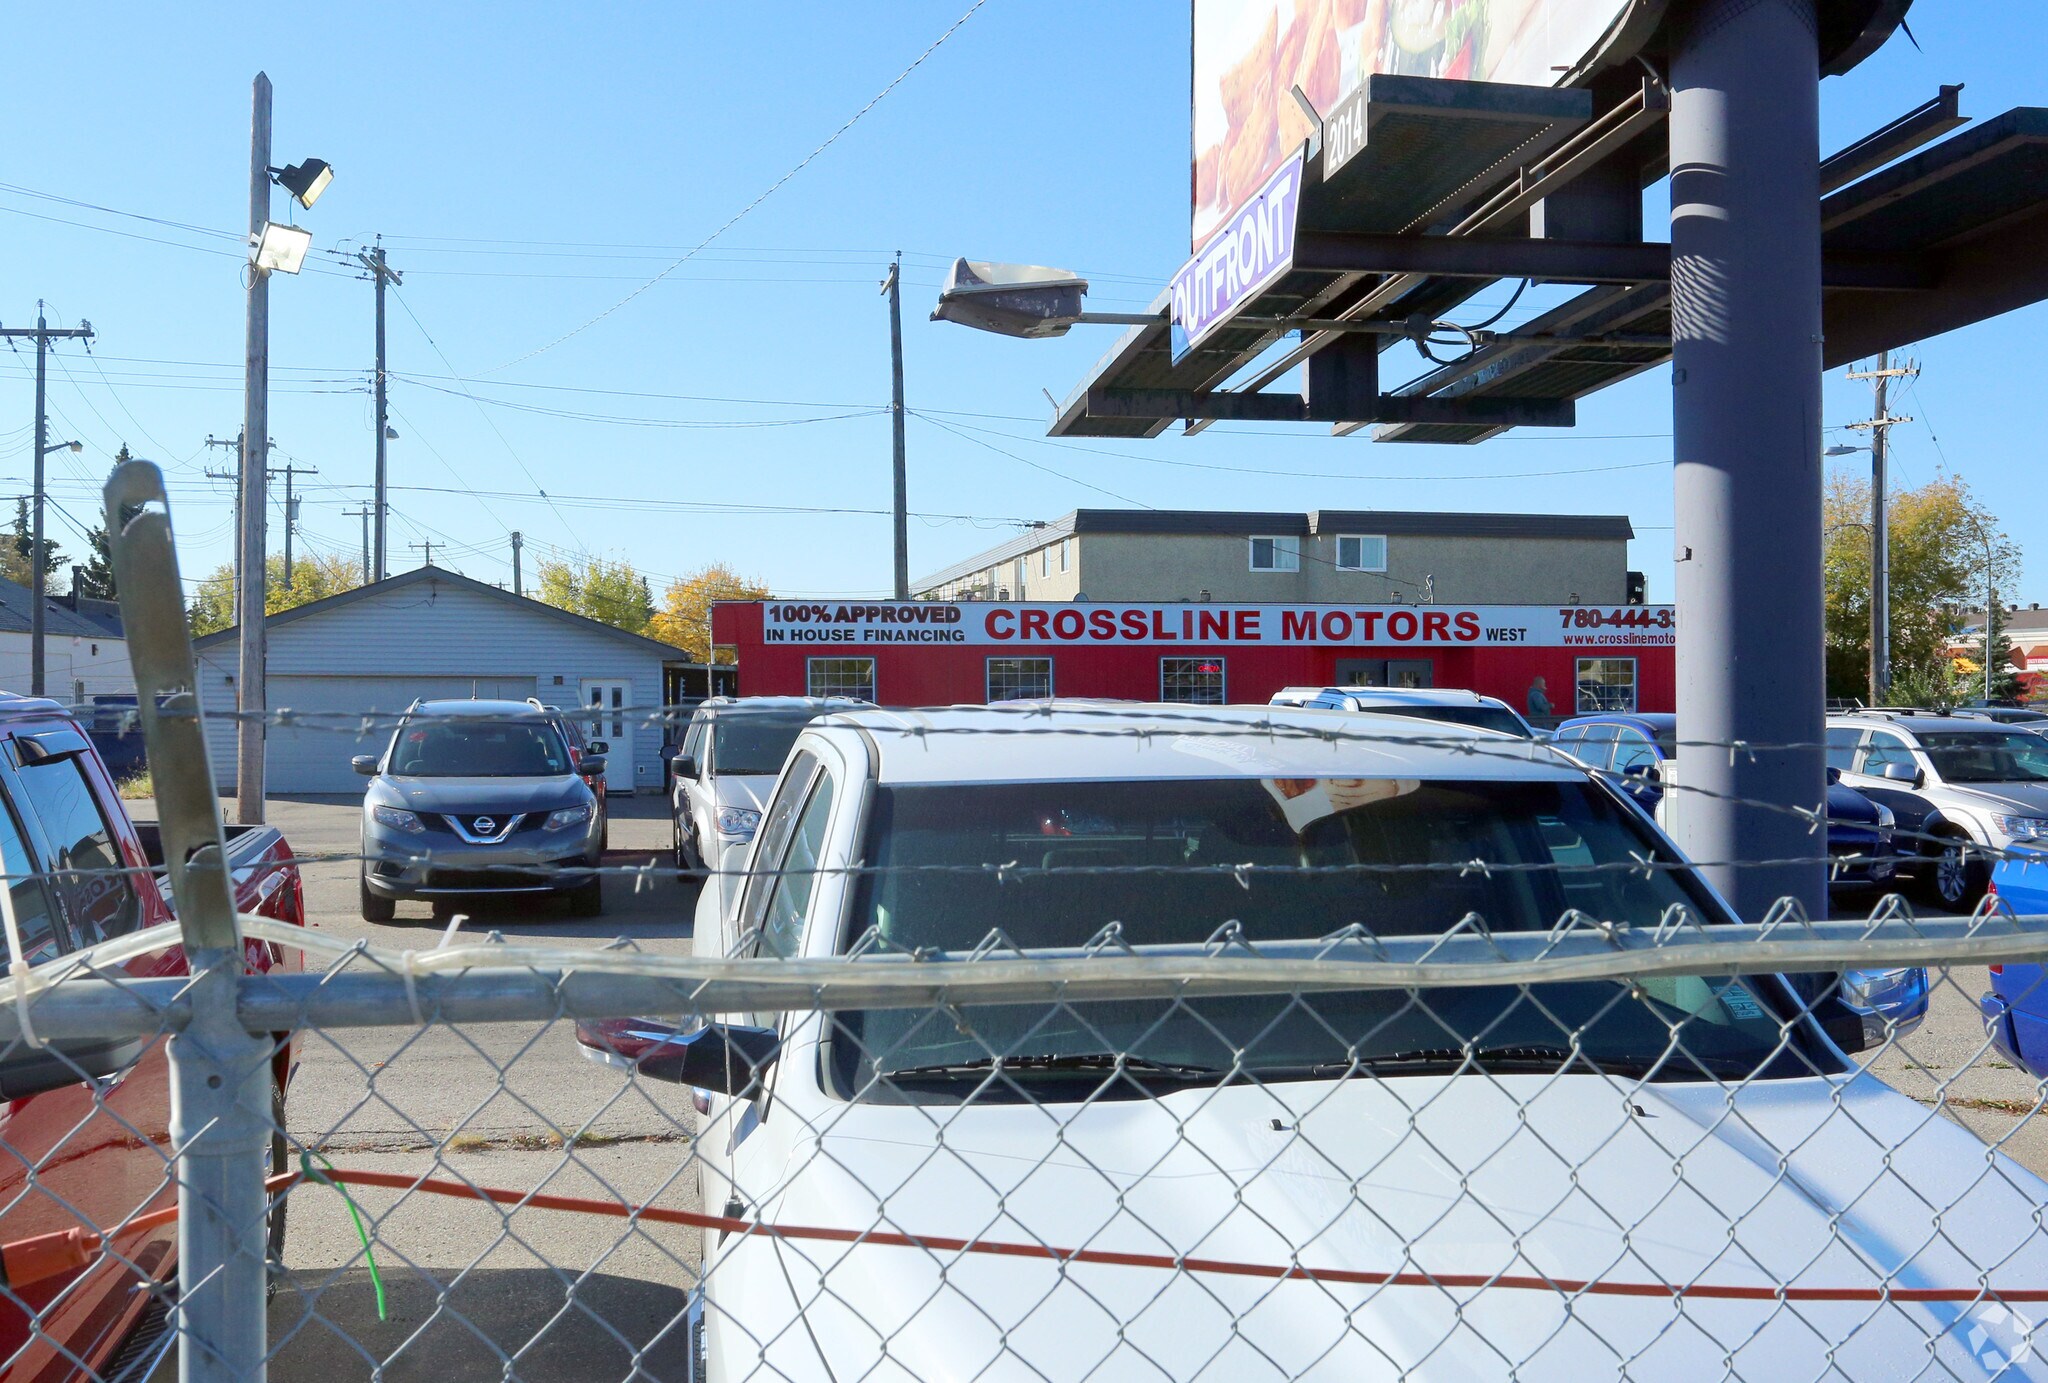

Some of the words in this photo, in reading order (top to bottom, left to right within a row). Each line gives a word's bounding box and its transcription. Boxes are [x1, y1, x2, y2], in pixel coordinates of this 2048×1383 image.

[1328, 97, 1363, 171] 2014
[1174, 172, 1292, 343] OUTFRONT
[766, 629, 784, 641] IN
[790, 629, 855, 641] HOUSE
[863, 629, 965, 642] FINANCING
[984, 609, 1261, 640] CROSSLINE
[1281, 610, 1481, 641] MOTORS
[1486, 628, 1527, 642] WEST
